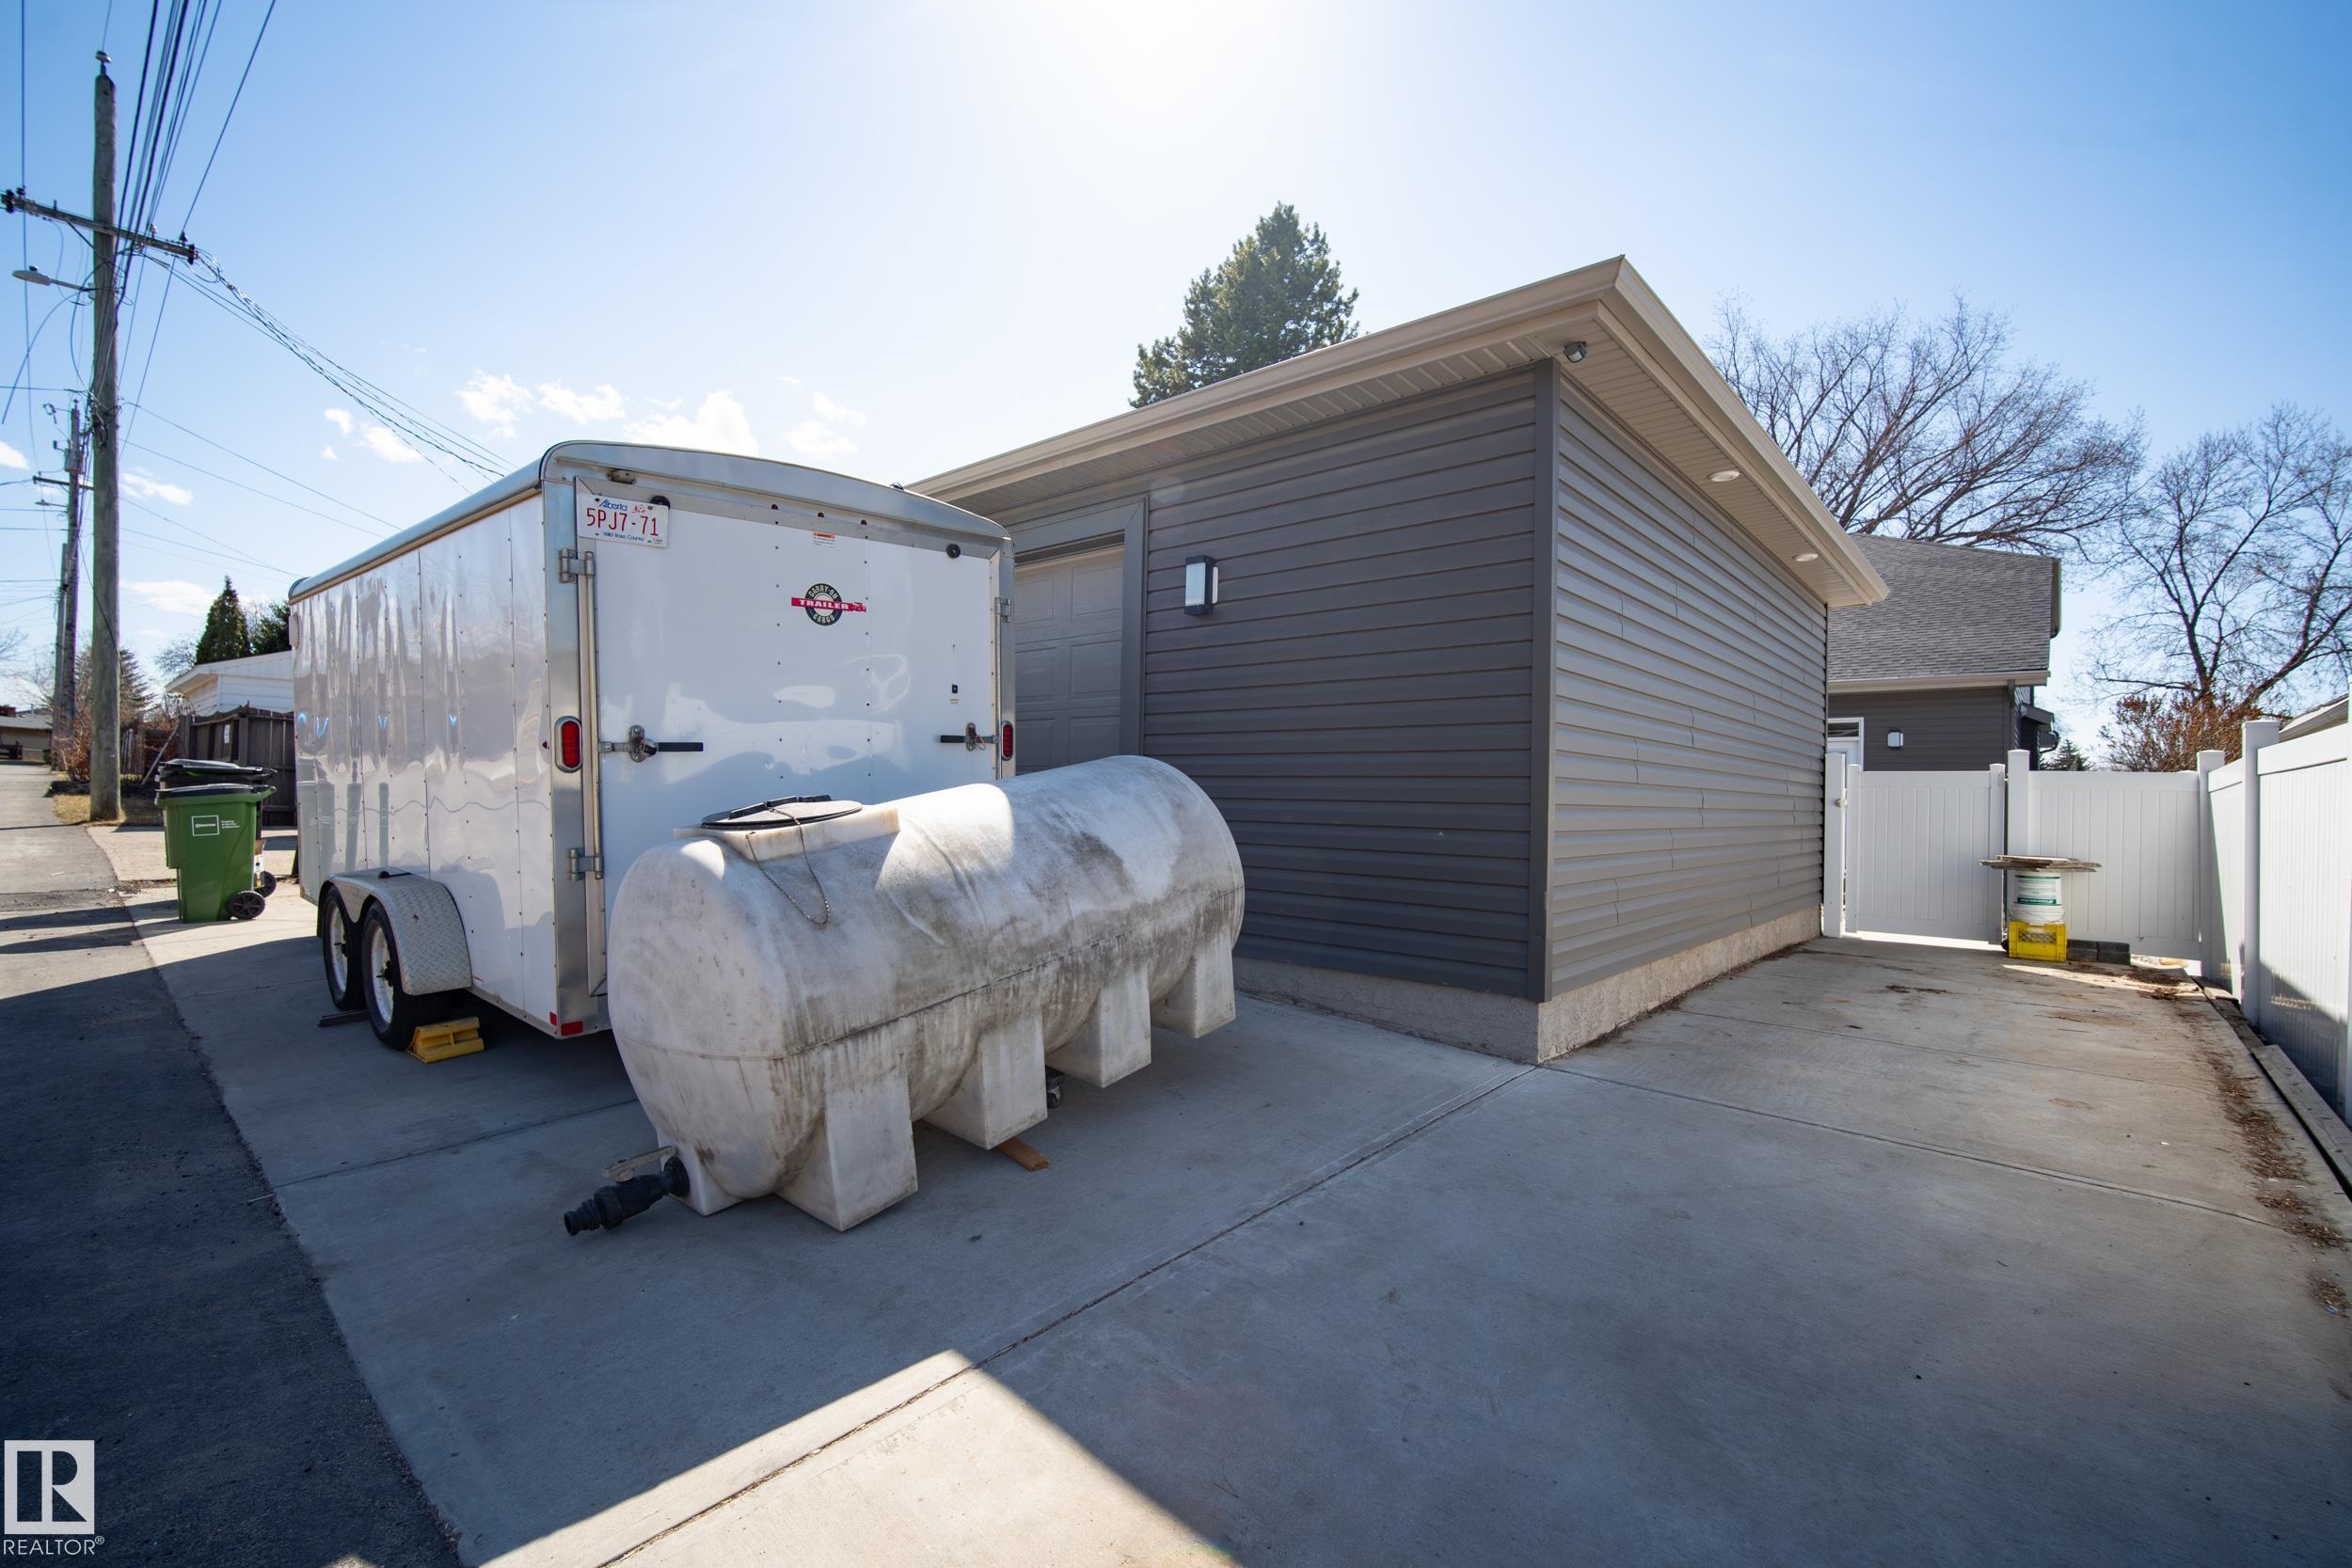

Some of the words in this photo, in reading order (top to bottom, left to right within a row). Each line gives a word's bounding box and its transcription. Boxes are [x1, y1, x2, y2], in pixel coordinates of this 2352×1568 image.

[599, 499, 628, 512] Alberta
[586, 507, 659, 536] 5PJ7-71
[808, 584, 838, 599] CARRY-ON
[799, 599, 849, 610] TRAILER
[812, 613, 835, 624] CARGO
